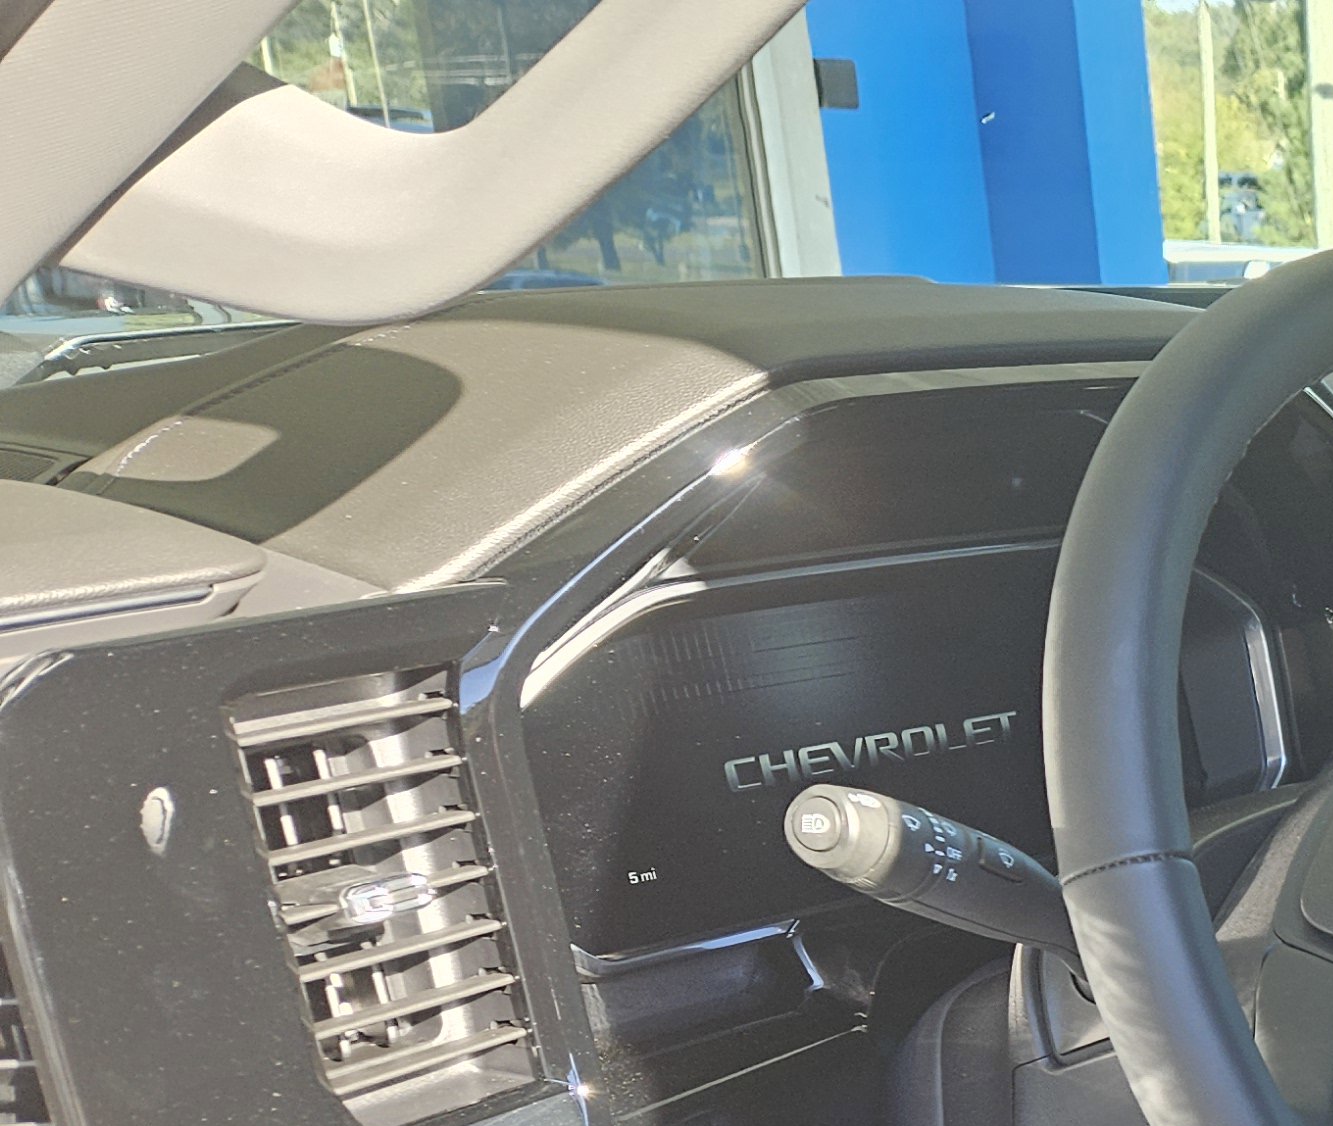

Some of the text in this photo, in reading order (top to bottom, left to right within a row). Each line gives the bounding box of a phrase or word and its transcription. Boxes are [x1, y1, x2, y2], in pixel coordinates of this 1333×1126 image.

[724, 710, 1017, 793] CHEVROLET
[628, 867, 658, 885] 5 mi
